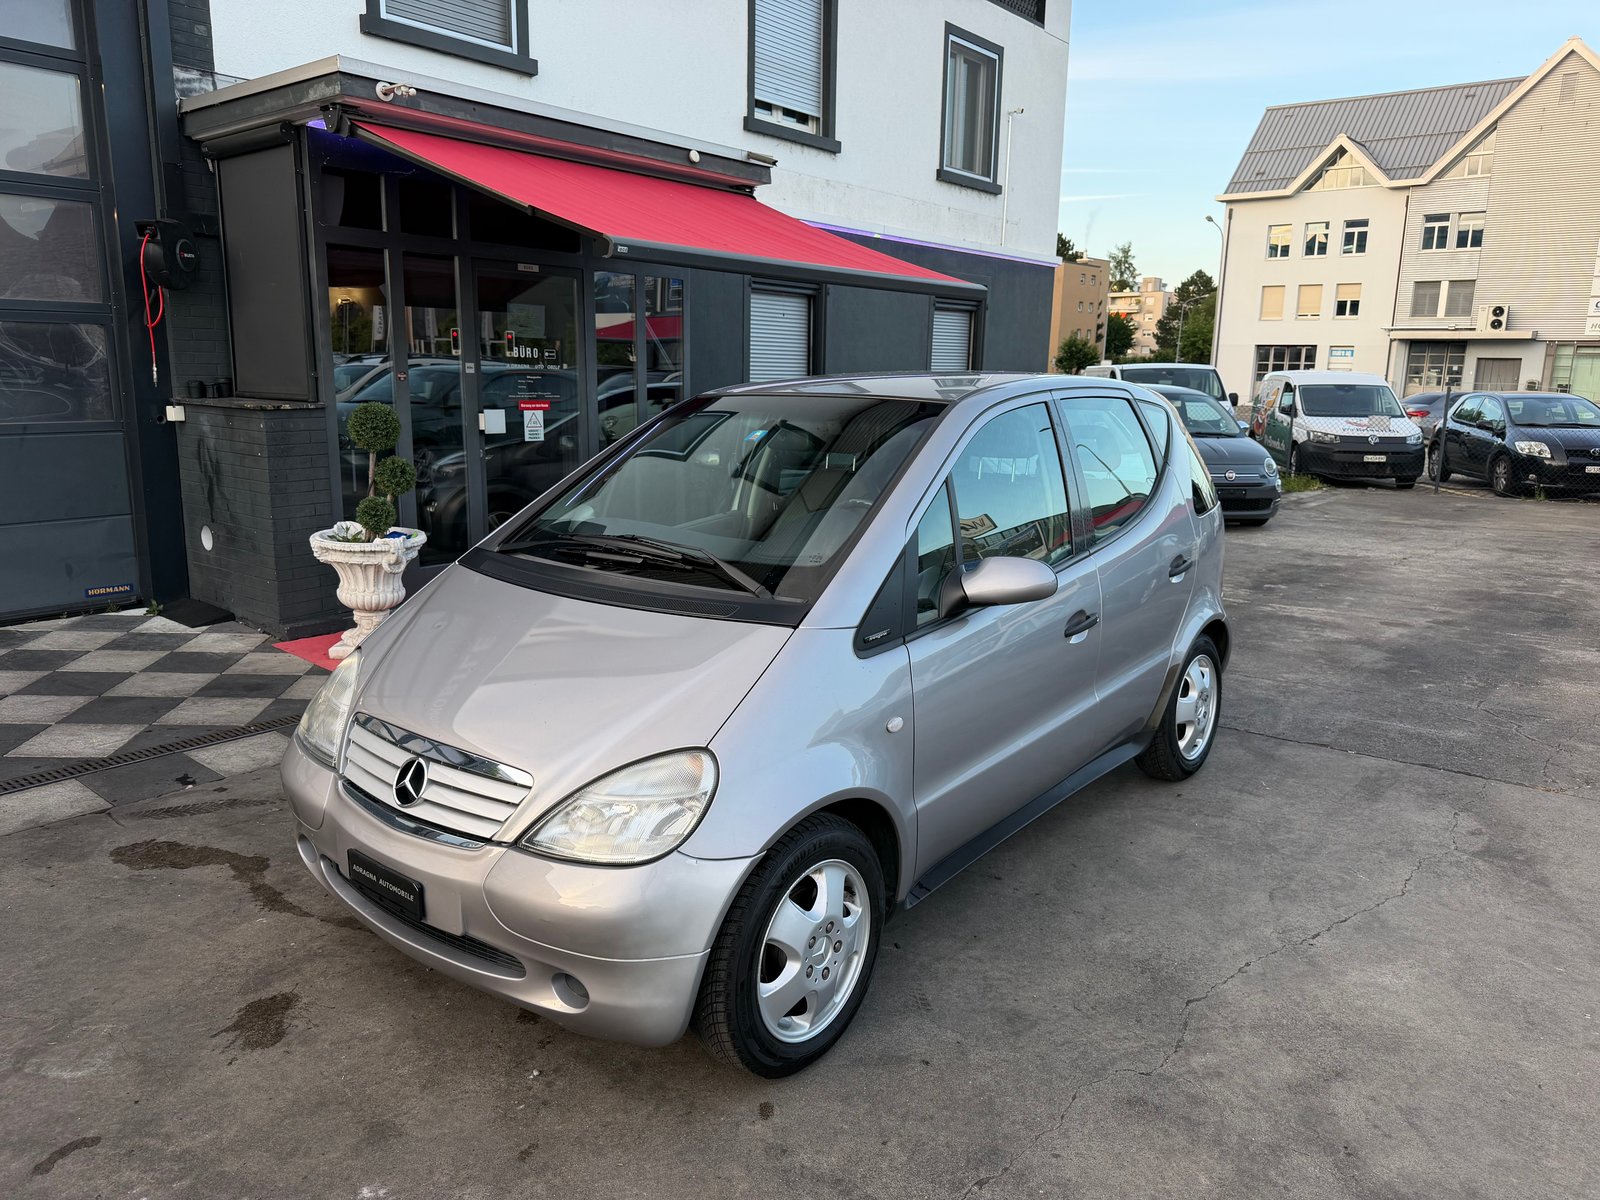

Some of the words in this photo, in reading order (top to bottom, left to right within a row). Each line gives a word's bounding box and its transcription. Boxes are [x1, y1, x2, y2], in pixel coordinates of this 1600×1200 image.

[513, 345, 538, 358] BÜRO
[352, 863, 377, 882] ADRAGNA
[379, 878, 414, 902] AUTOMOBILE
